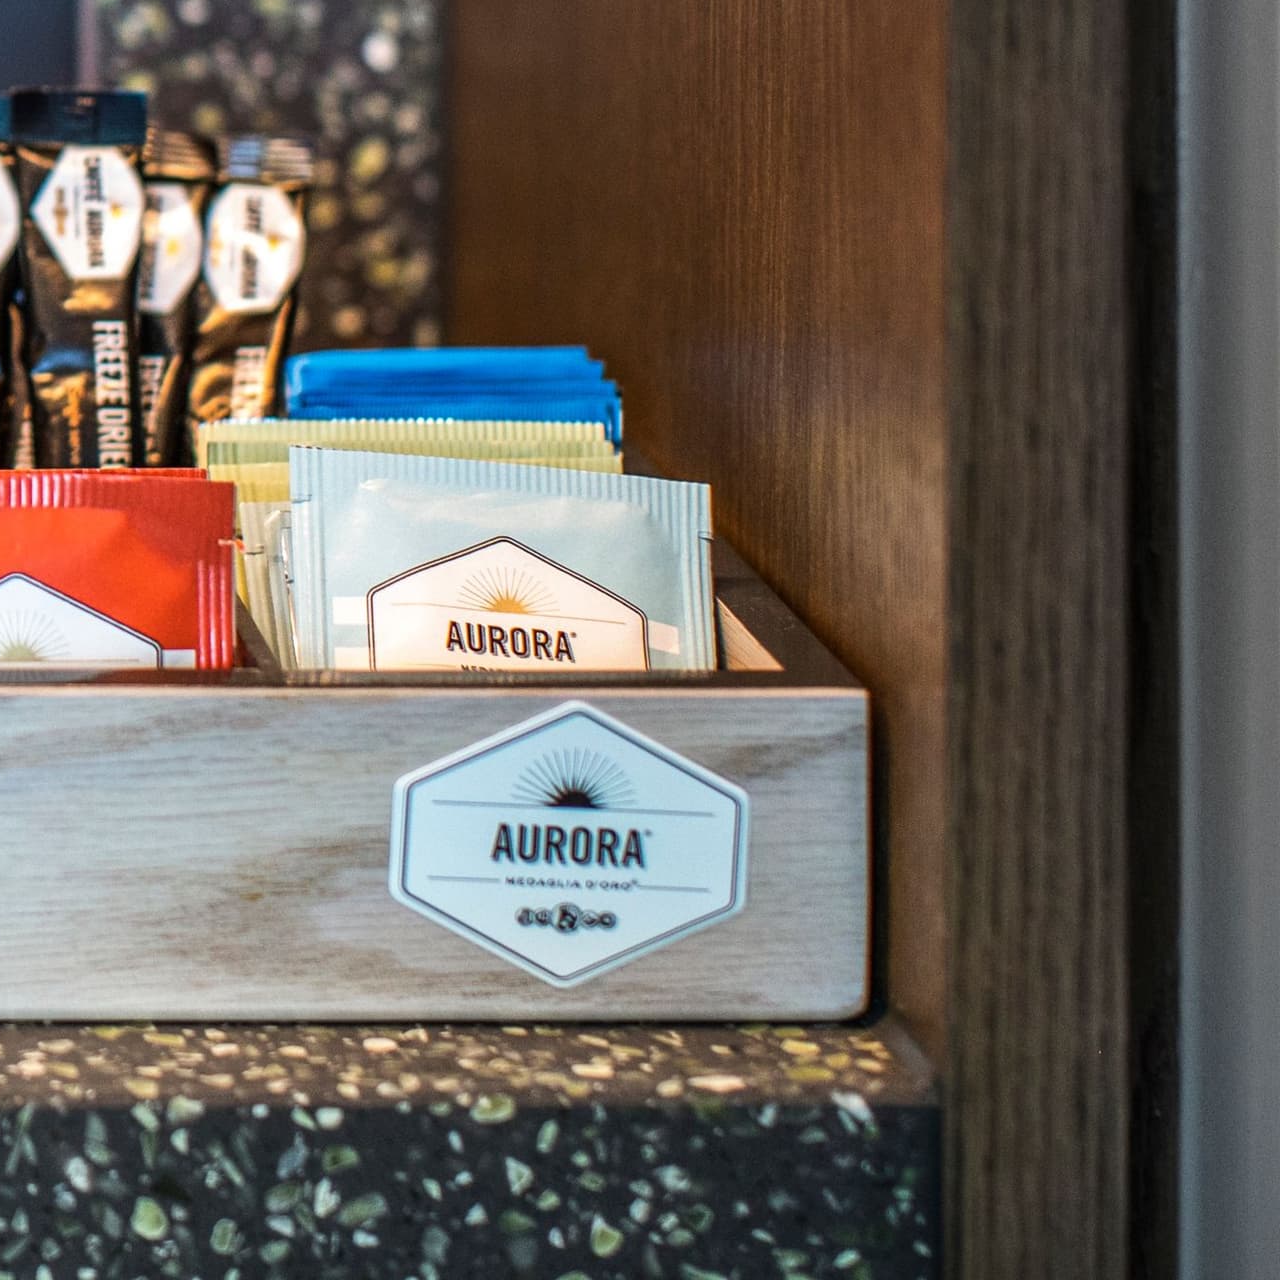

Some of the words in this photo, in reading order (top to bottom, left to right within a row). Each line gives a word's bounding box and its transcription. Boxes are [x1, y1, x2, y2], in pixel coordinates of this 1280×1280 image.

[93, 320, 130, 406] FREEZE
[97, 406, 132, 468] DRIE
[505, 876, 581, 889] MEDAGLIA
